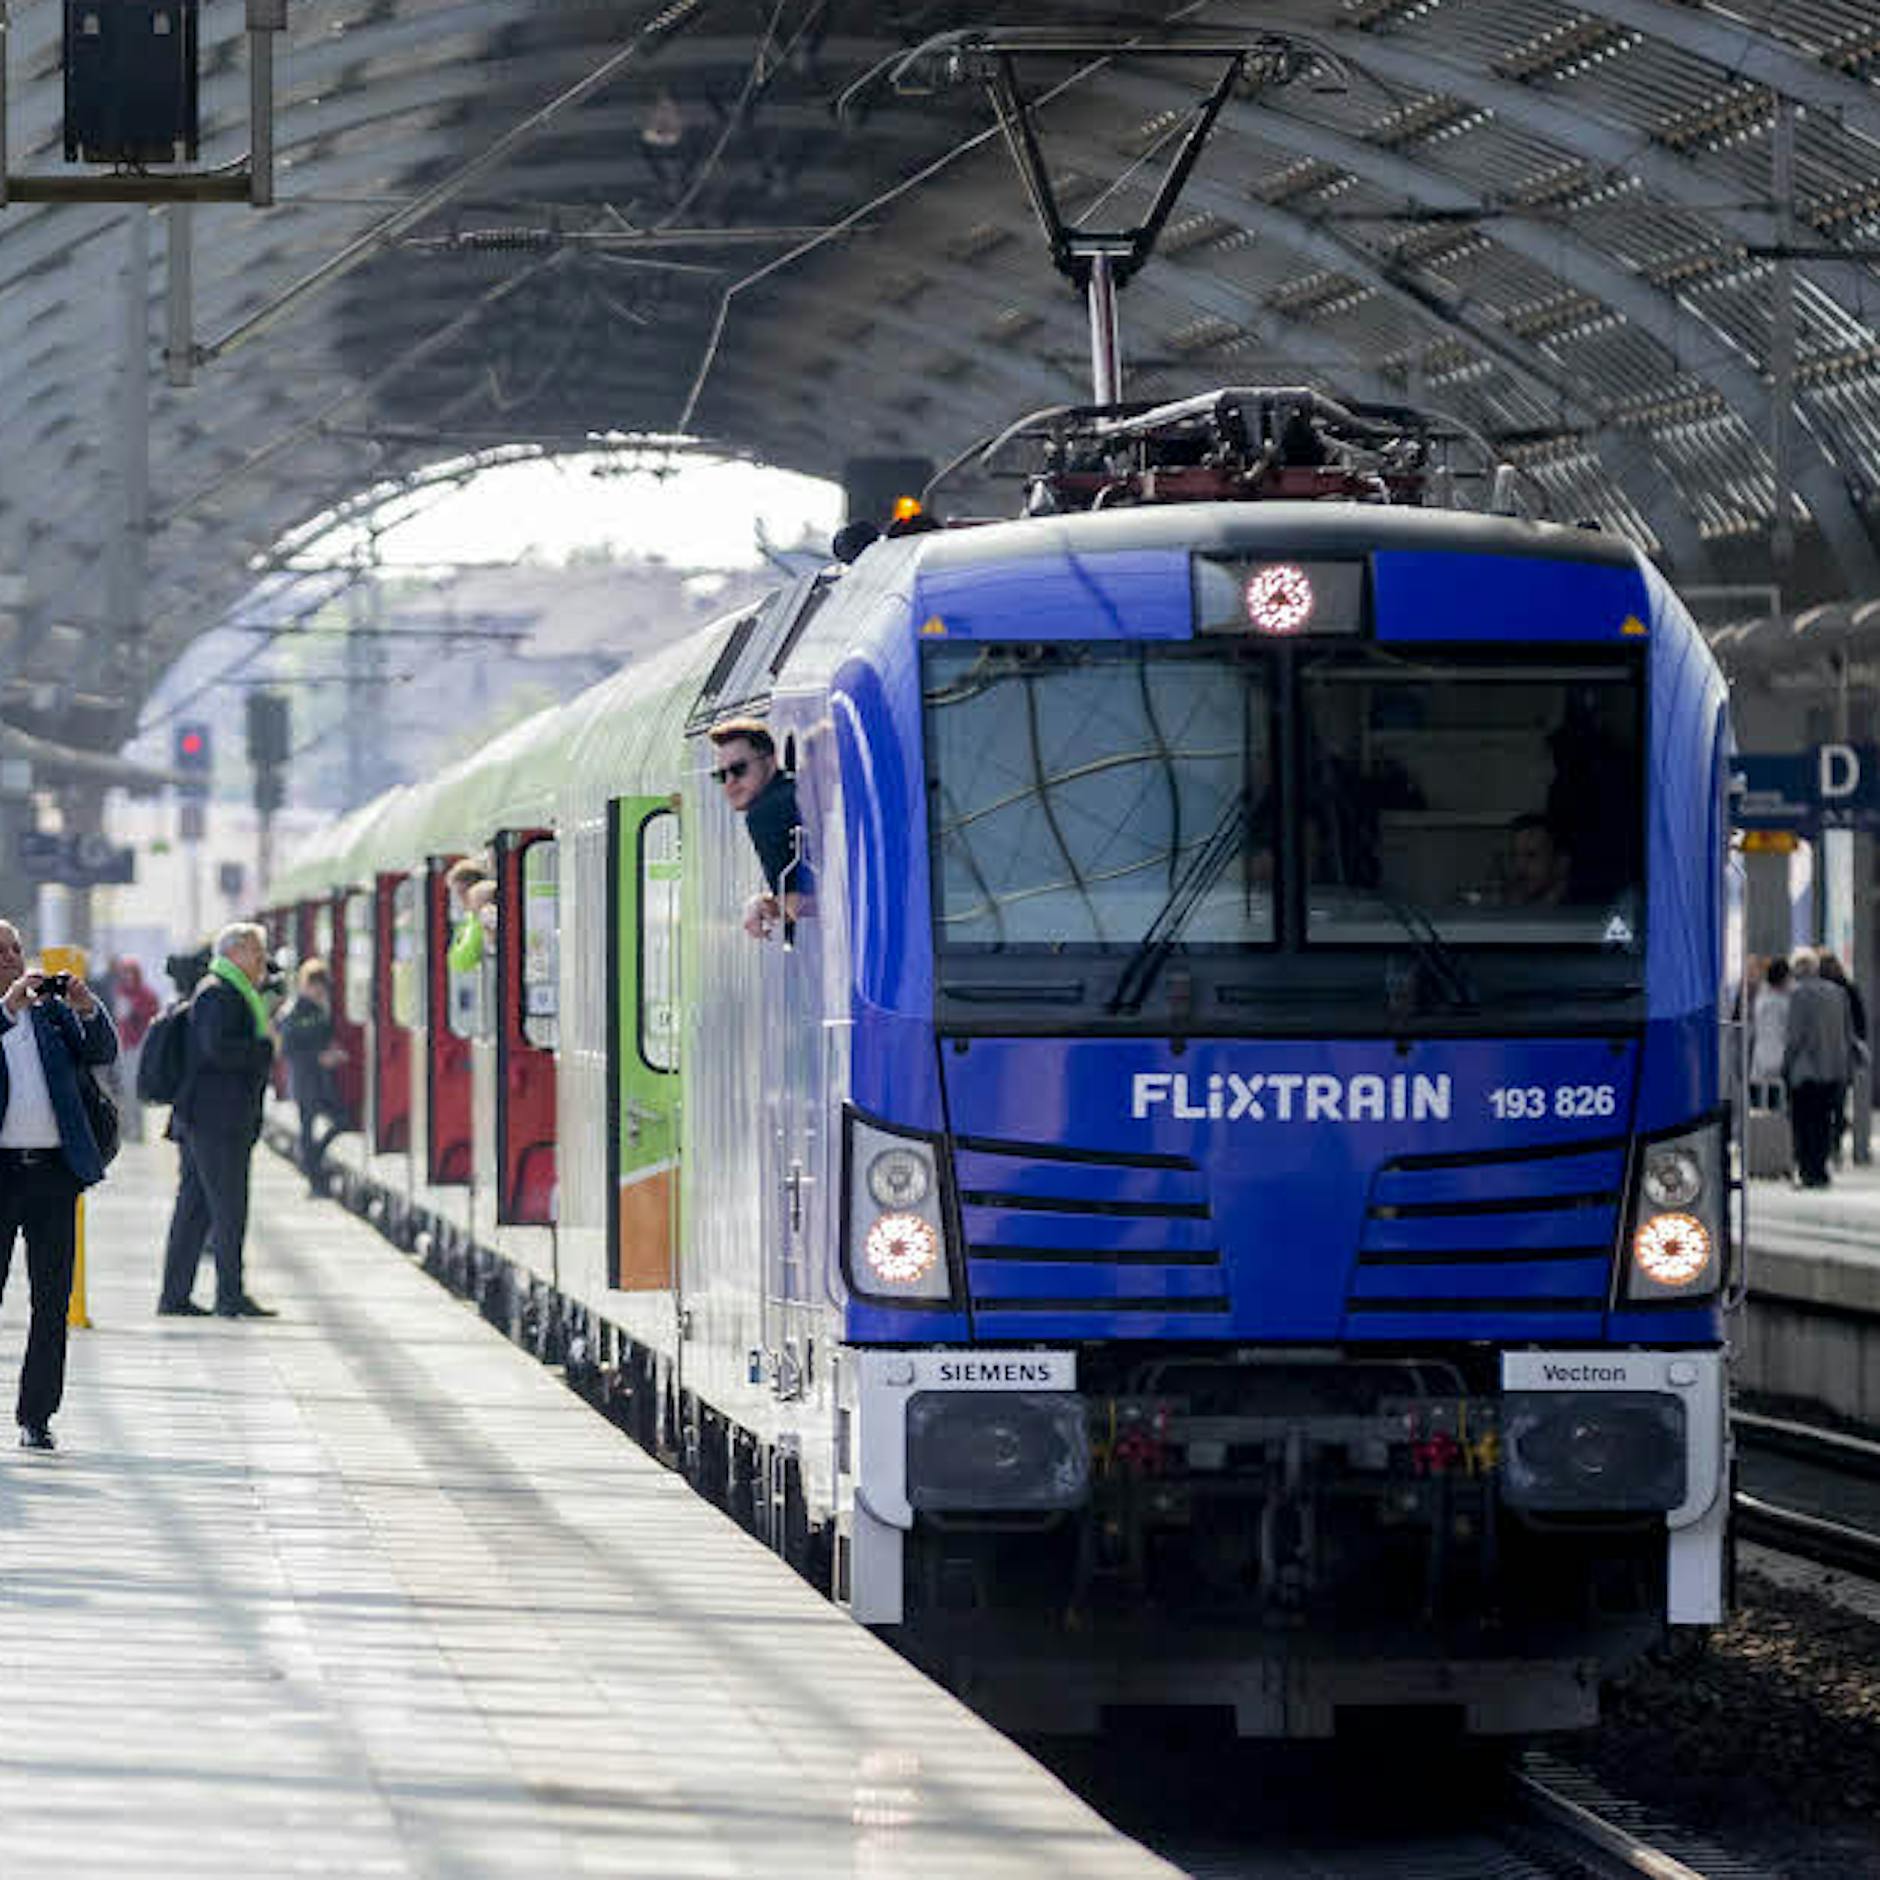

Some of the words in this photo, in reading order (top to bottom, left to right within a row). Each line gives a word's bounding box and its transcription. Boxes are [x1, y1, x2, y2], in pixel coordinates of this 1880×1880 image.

[1820, 744, 1860, 797] D
[1488, 1086, 1546, 1119] 193
[1554, 1084, 1616, 1118] 826
[940, 1363, 1051, 1382] SIEMENS
[1543, 1365, 1626, 1382] Vectron
